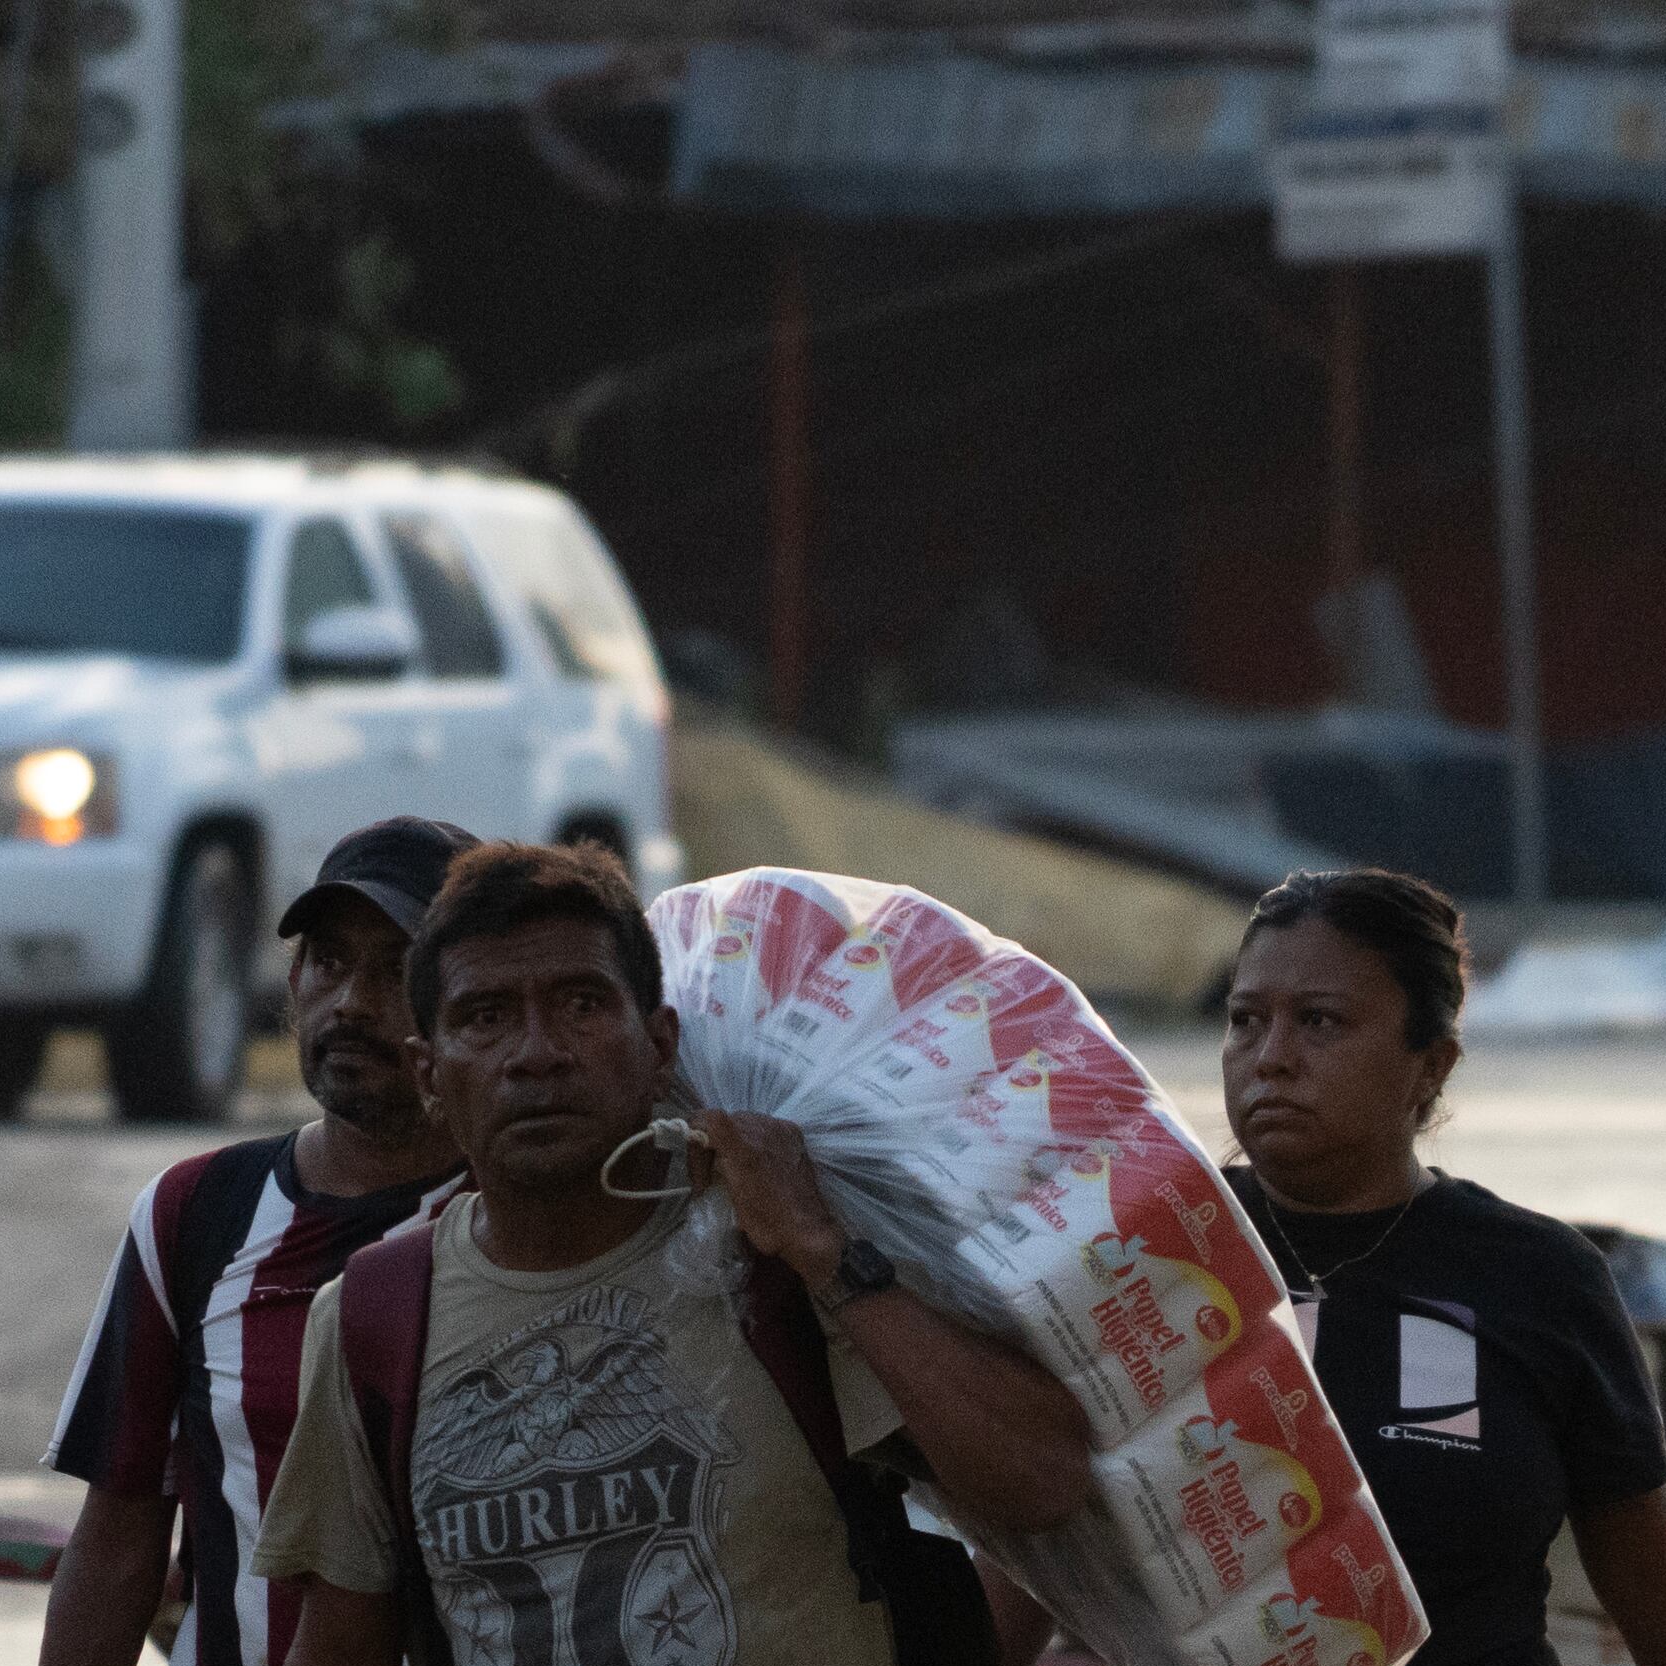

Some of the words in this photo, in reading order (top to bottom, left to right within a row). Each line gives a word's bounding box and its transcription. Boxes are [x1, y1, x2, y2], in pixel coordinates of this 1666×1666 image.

[1092, 1296, 1169, 1410] Higiénico
[1125, 1276, 1186, 1354] Papel
[1378, 1425, 1482, 1451] Champion
[435, 1466, 679, 1560] HURLEY
[1181, 1479, 1247, 1593] Higiénico
[1213, 1461, 1266, 1538] Papel
